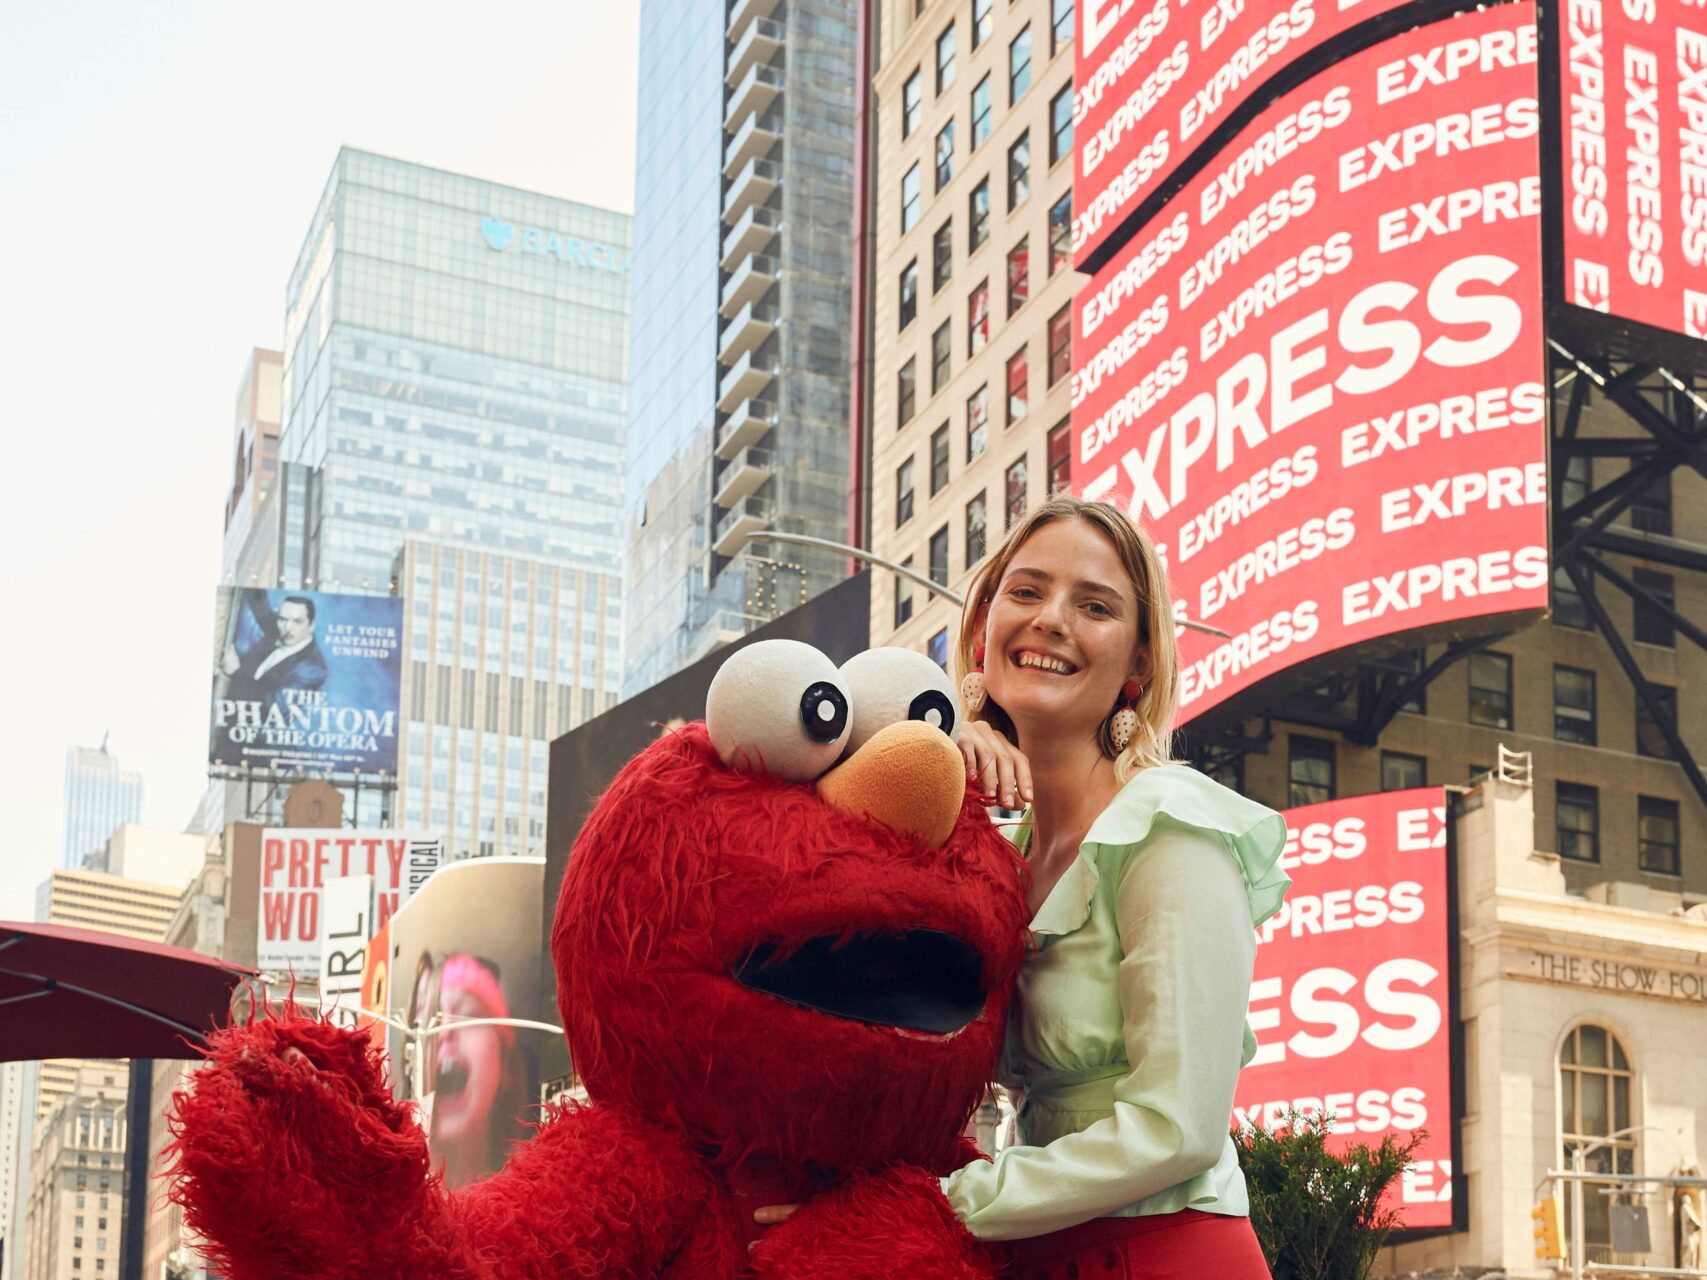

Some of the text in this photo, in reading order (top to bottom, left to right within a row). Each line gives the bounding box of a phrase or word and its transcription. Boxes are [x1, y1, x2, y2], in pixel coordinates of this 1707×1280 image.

[1083, 40, 1189, 177] EXPRESS
[1180, 0, 1315, 142] EXPRESS
[1568, 0, 1609, 239] EXPRESS
[1180, 174, 1316, 311] EXPRESS
[1339, 97, 1540, 193] EXPRES
[1623, 43, 1665, 288] EXPRESS
[1082, 211, 1189, 338] EXPRESS
[1200, 86, 1352, 225] EXPRESS
[1081, 346, 1189, 464] EXPRESS
[1200, 231, 1353, 362] EXPRESS
[1179, 382, 1545, 563] EXPRESS EXPRES
[1200, 507, 1355, 620] EXPRESS
[324, 634, 398, 649] FANTASIES
[327, 624, 396, 638] LET YOUR
[332, 646, 389, 659] UNWIND
[1179, 600, 1319, 707] EXPRESS
[1342, 546, 1548, 626] EXPRES
[215, 700, 396, 737] PHANTOM
[229, 727, 379, 752] OF THE OPERA
[283, 689, 327, 706] THE
[263, 839, 407, 888] PRETTY
[409, 840, 439, 895] SICAL
[1255, 881, 1425, 945] PRESS
[1535, 952, 1581, 982] THE
[1591, 960, 1657, 990] SHOW
